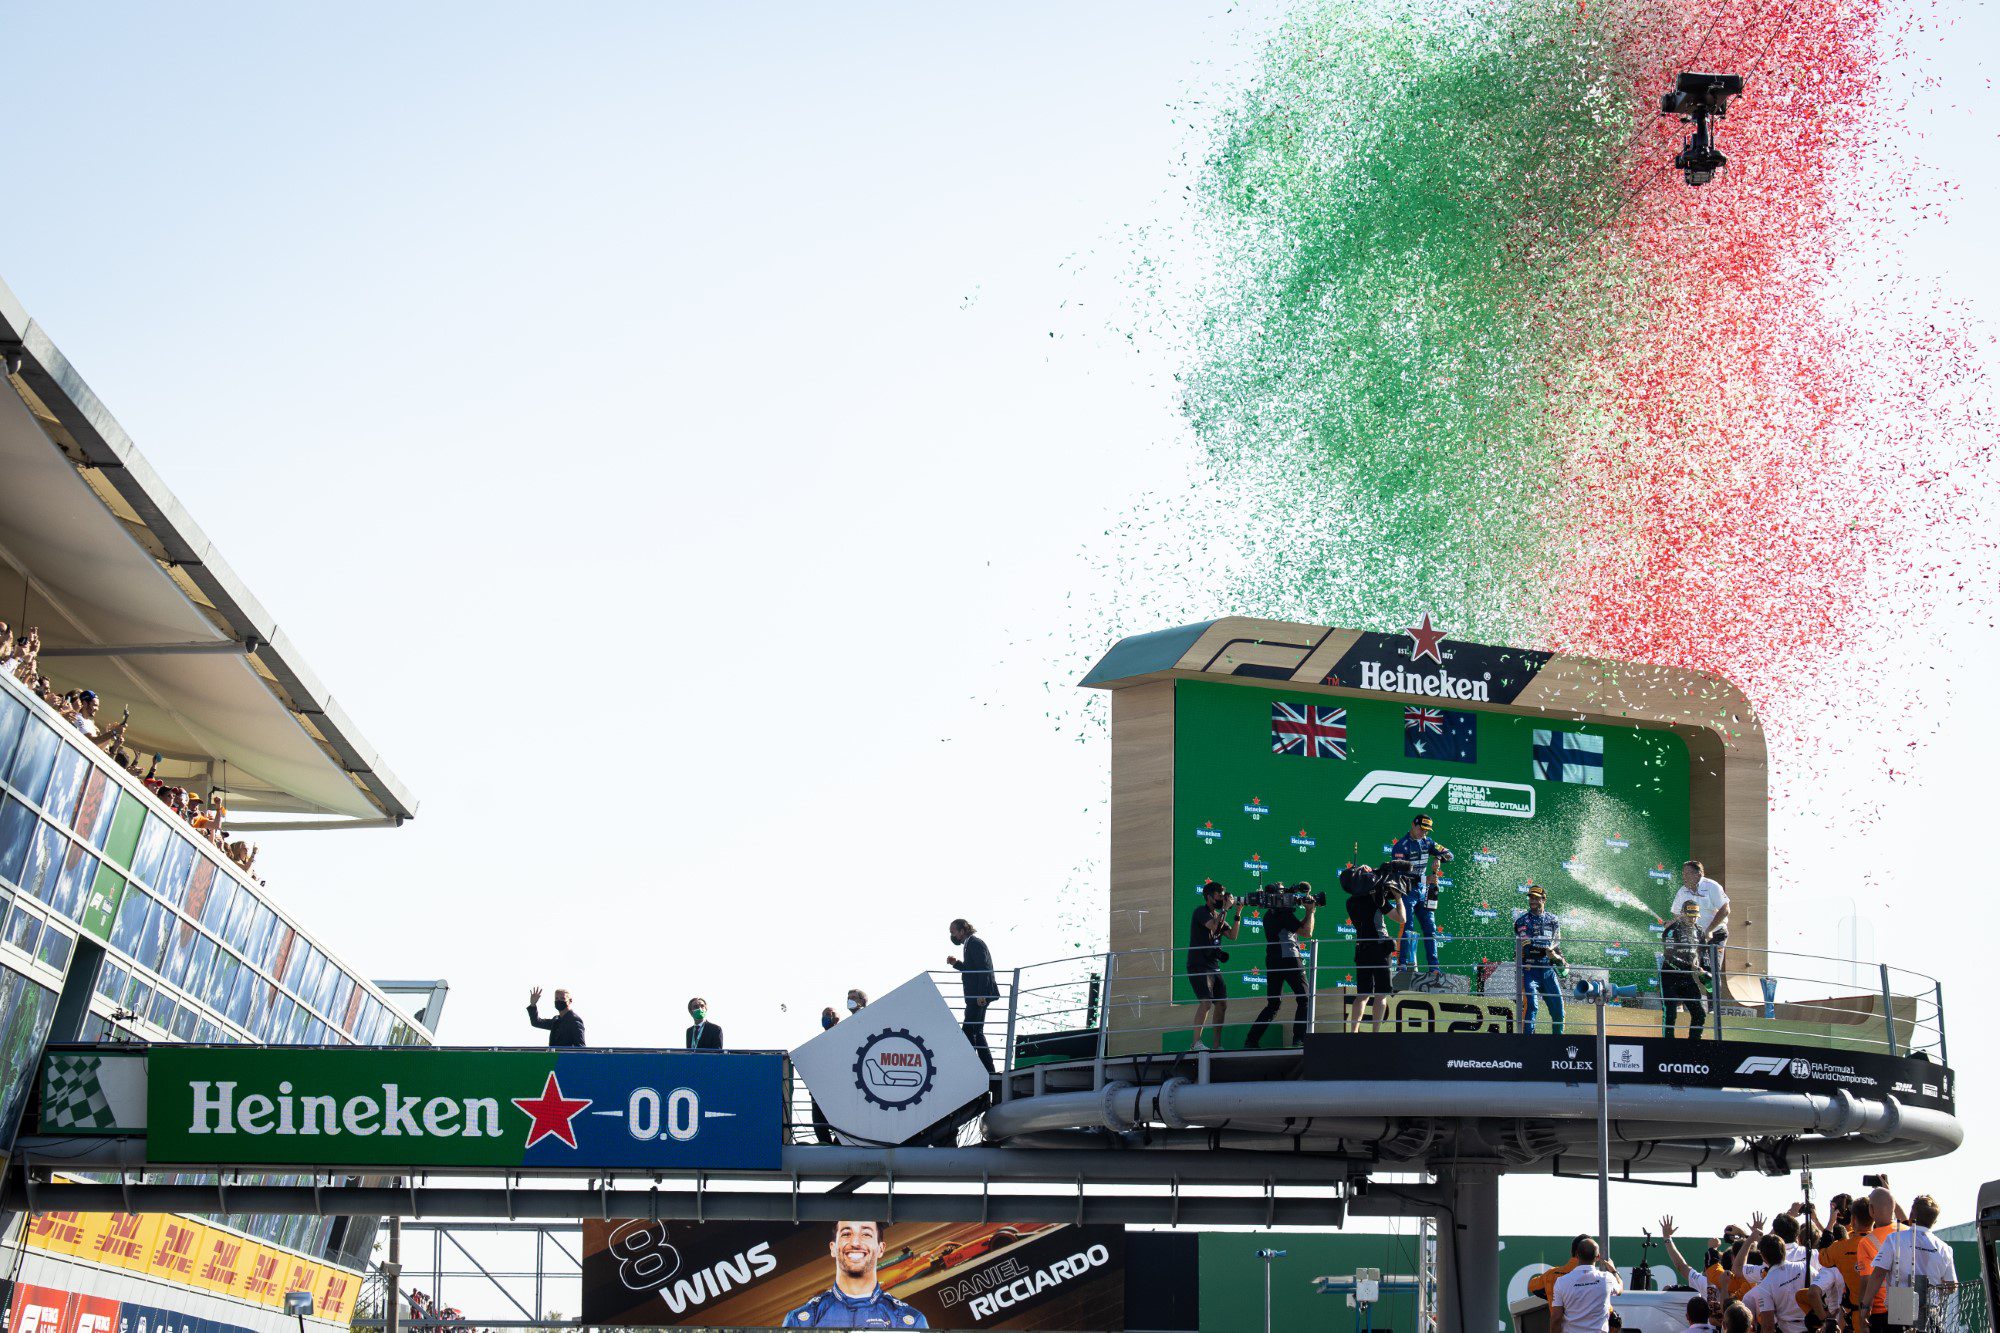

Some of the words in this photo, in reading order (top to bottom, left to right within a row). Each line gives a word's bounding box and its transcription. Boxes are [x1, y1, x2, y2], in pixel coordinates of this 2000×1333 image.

[1448, 784, 1486, 794] FORMULA
[1486, 787, 1491, 795] 1
[1448, 797, 1470, 806] GRAN
[1471, 799, 1499, 808] PREMIO
[880, 1052, 922, 1067] MONZA
[1446, 1059, 1523, 1070] #WeRaceAsOne
[1551, 1060, 1594, 1071] ROLEX
[1612, 1060, 1640, 1069] Emirates
[1658, 1063, 1709, 1075] aramco
[1811, 1062, 1823, 1071] FIA
[1823, 1063, 1850, 1073] Formula
[1851, 1066, 1855, 1075] 1
[1811, 1071, 1832, 1081] World
[188, 1080, 504, 1137] Heineken
[628, 1086, 702, 1142] 0.0
[609, 1218, 680, 1290] 8
[658, 1241, 777, 1314] WINS
[938, 1257, 1029, 1308] DANIEL
[969, 1244, 1109, 1321] RICCIARDO
